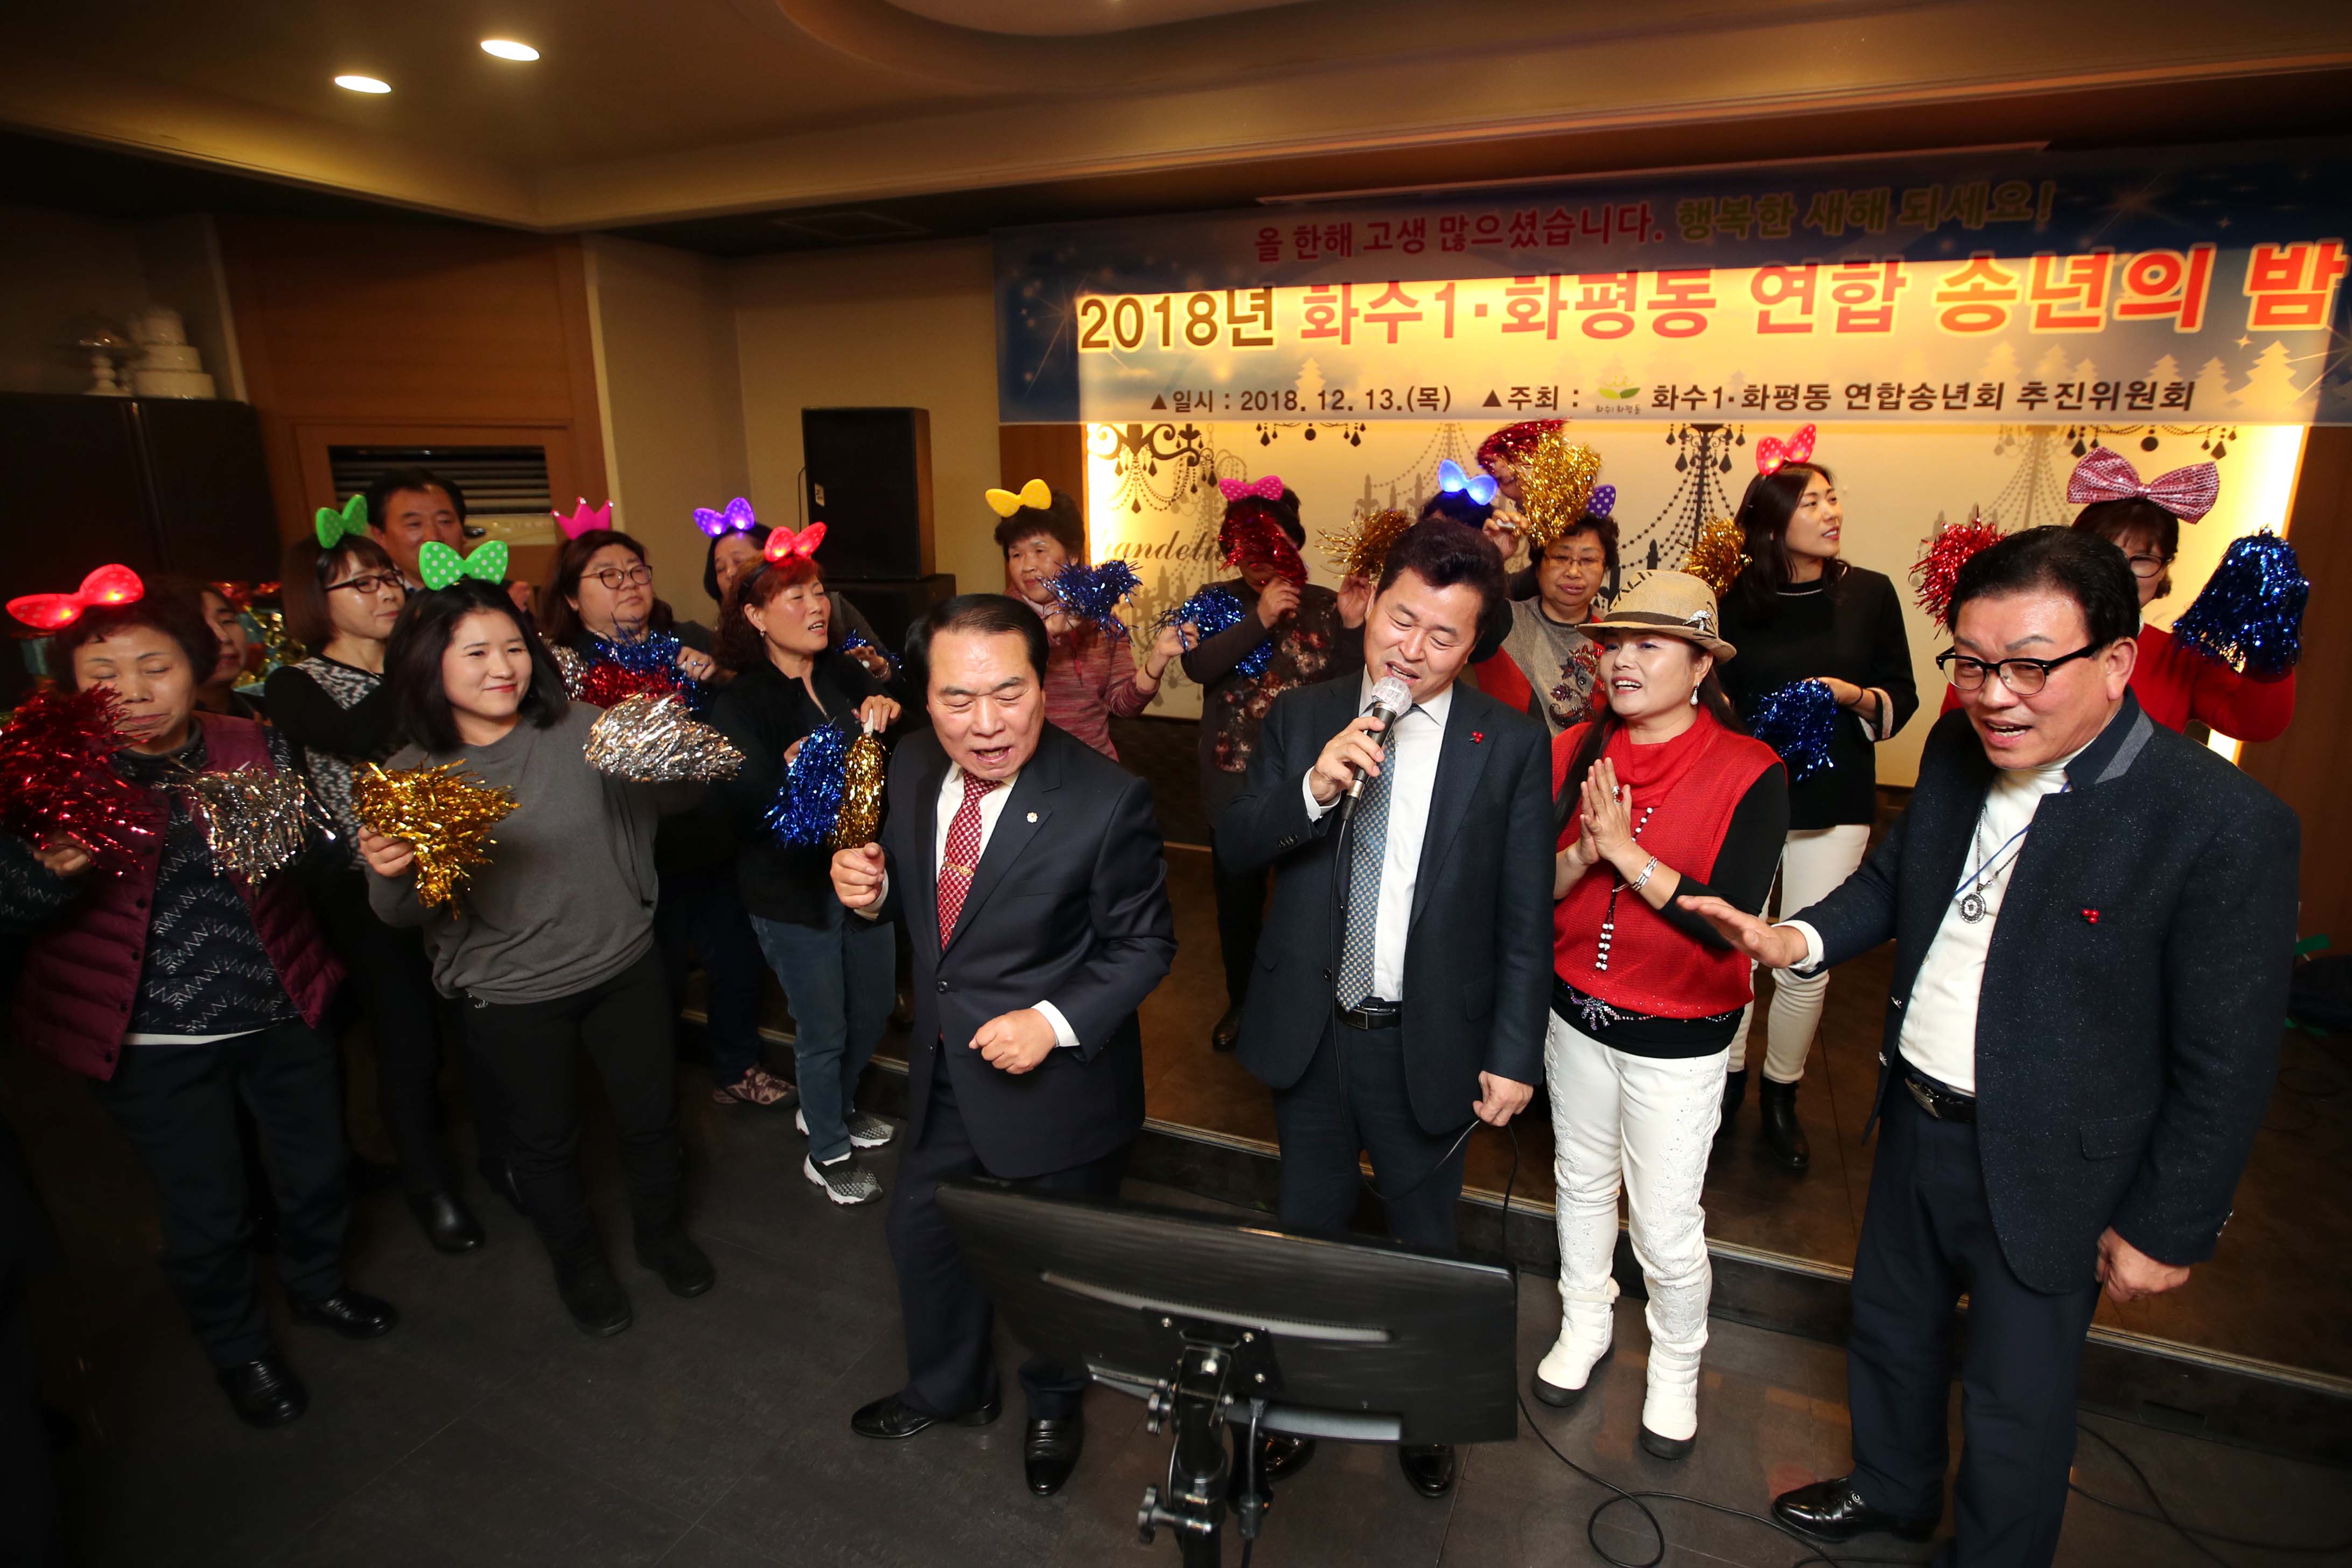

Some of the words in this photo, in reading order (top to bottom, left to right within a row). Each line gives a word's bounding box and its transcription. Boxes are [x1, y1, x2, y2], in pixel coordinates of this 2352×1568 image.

[1255, 227, 1283, 262] 올
[1293, 223, 1353, 260] 한해
[1363, 217, 1426, 254] 고생
[1439, 204, 1663, 251] 많으셨습니다.
[1677, 194, 1793, 241] 행복한
[1803, 186, 1890, 235] 새해
[1898, 180, 2056, 232] 되세요!
[1080, 286, 1274, 348] 2018년
[1750, 258, 1907, 334] 연합
[1936, 247, 2213, 333] 송년의
[2249, 242, 2347, 327] 밤
[1173, 390, 1213, 412] 일시
[1241, 389, 1306, 411] 2018.
[1318, 389, 1353, 411] 12.
[1366, 385, 1451, 412] 13.(목)
[1508, 386, 1559, 411] 주최
[1844, 381, 2005, 411] 연합송년회
[2016, 380, 2196, 411] 추진위원회
